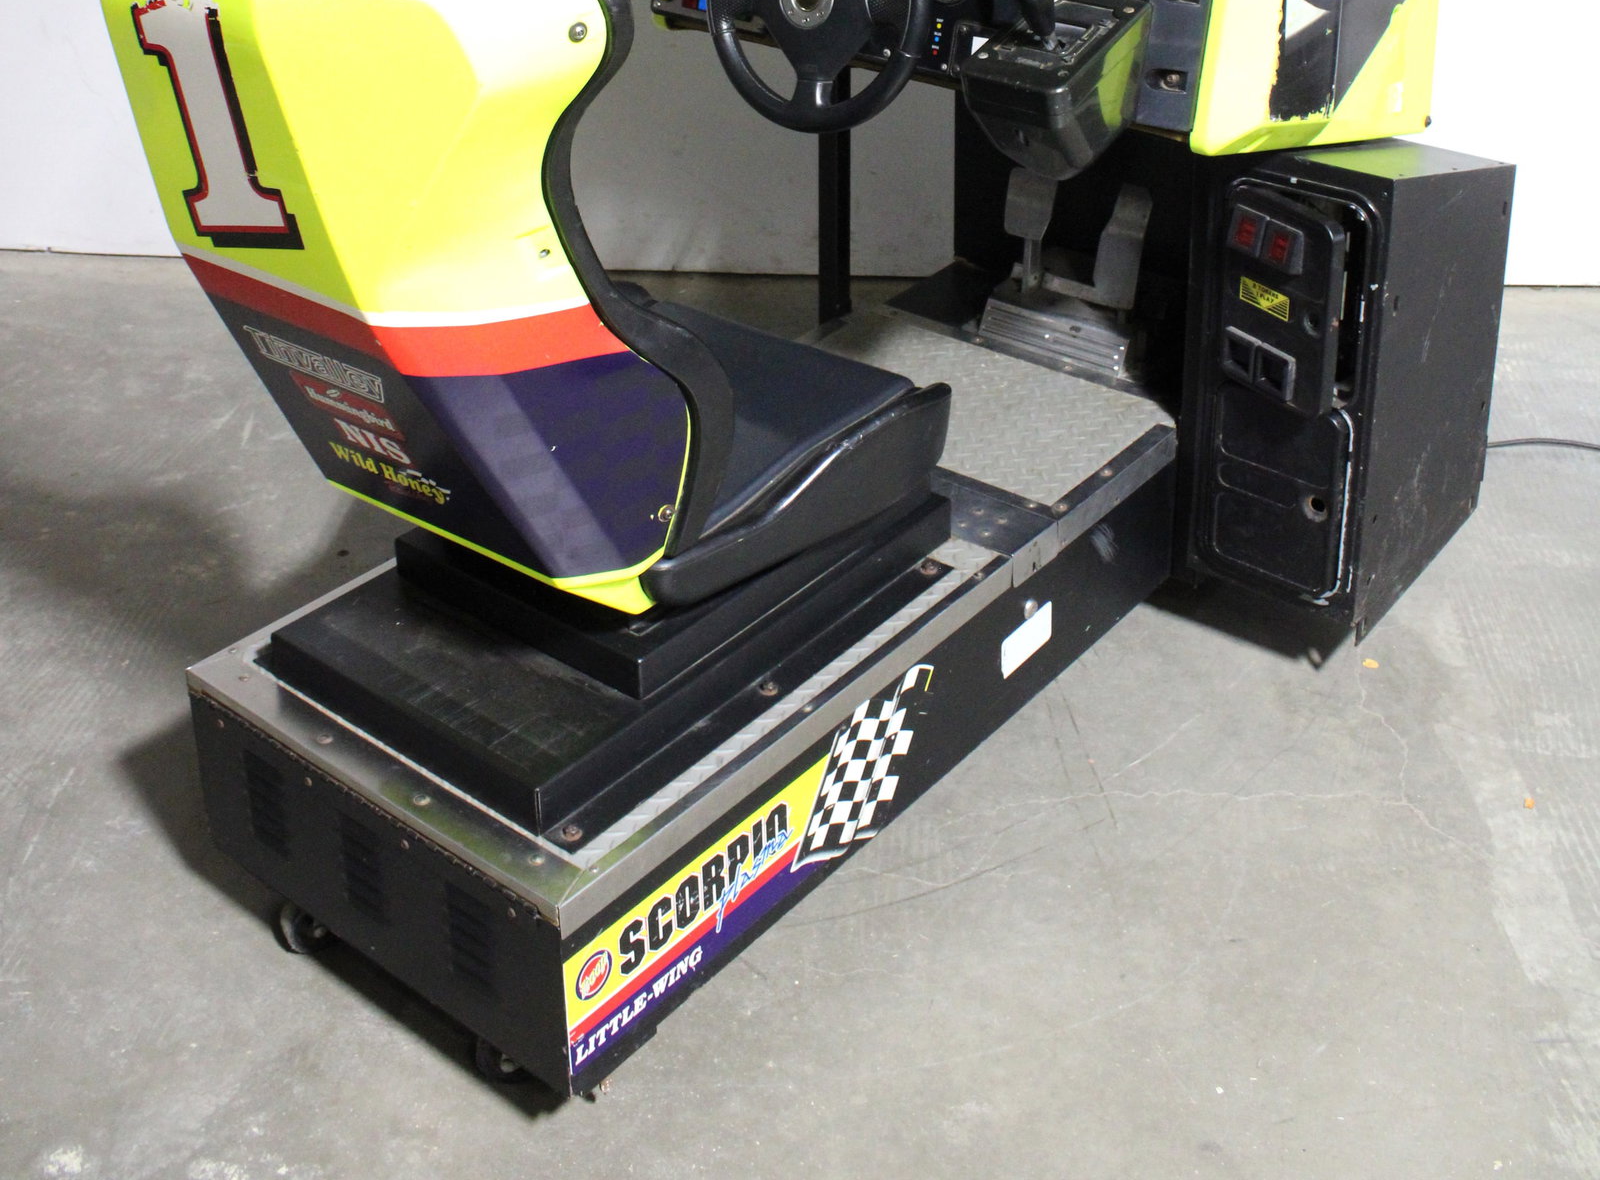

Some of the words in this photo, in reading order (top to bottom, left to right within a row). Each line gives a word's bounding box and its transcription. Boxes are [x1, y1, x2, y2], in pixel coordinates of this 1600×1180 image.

[243, 325, 383, 402] Tinvalley
[328, 441, 379, 475] Wild
[333, 418, 412, 465] NIS
[575, 946, 703, 1066] LITTLE-WING
